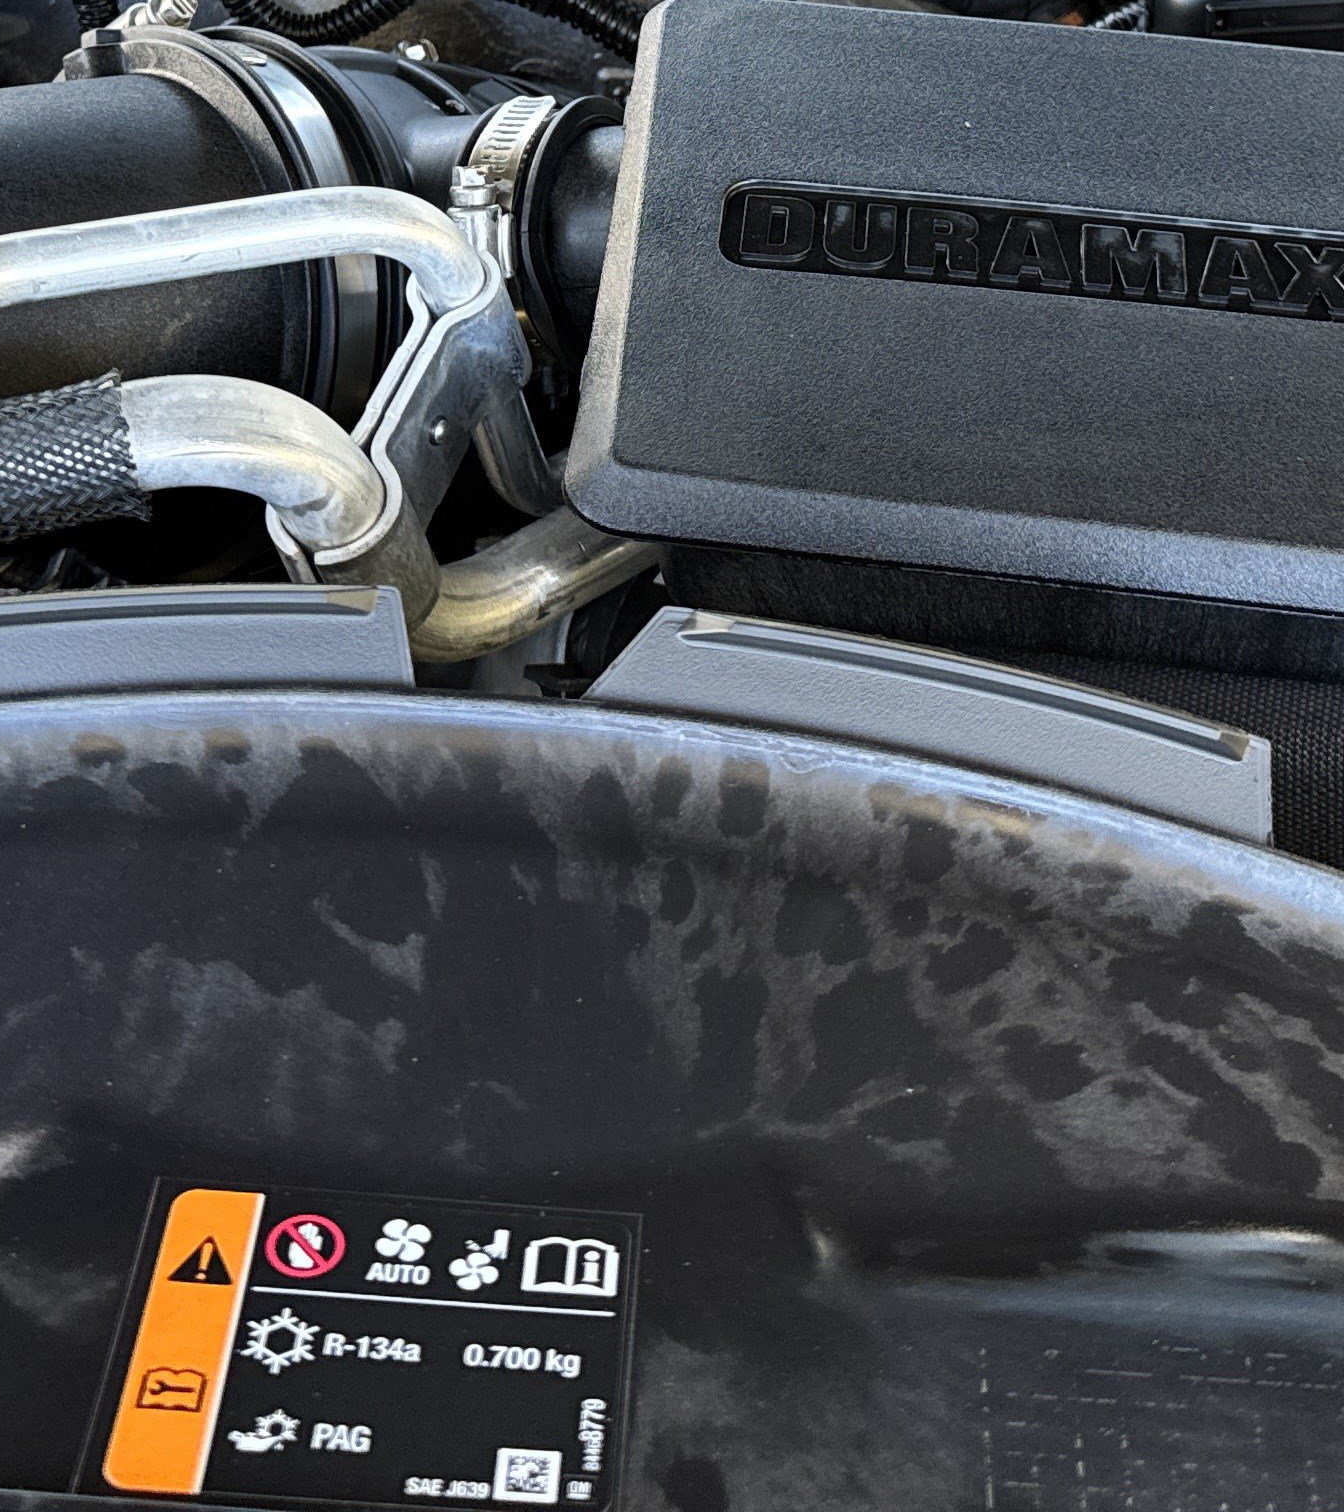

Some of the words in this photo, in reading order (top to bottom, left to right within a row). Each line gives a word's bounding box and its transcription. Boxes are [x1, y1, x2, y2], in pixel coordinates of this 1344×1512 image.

[365, 1262, 431, 1286] AUTO
[323, 1333, 421, 1363] R-134a
[463, 1345, 542, 1371] 0.700
[545, 1349, 581, 1378] kg
[311, 1424, 372, 1453] PAG
[404, 1477, 444, 1496] SAE
[445, 1480, 491, 1499] J639
